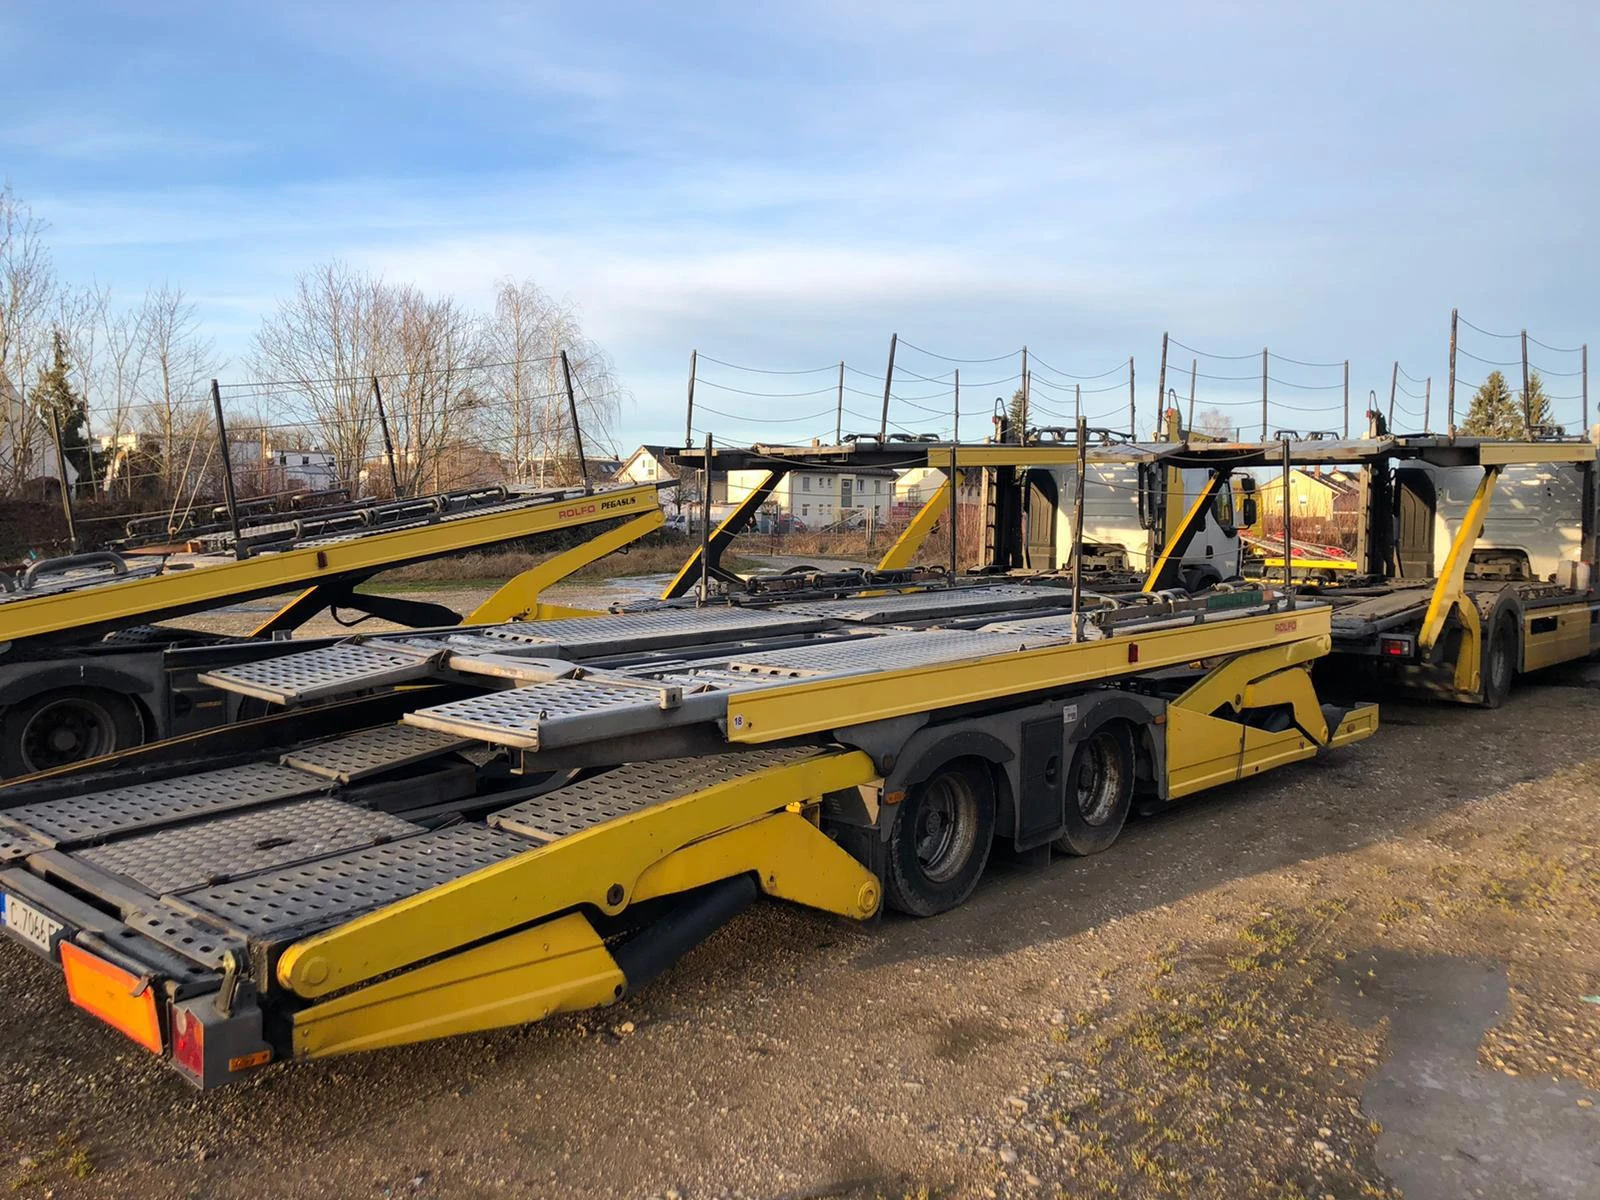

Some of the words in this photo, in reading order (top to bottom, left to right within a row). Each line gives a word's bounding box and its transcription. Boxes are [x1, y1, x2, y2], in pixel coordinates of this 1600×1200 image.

[559, 504, 596, 519] ROLFO
[601, 496, 637, 511] PEGASUS
[734, 716, 743, 726] 18
